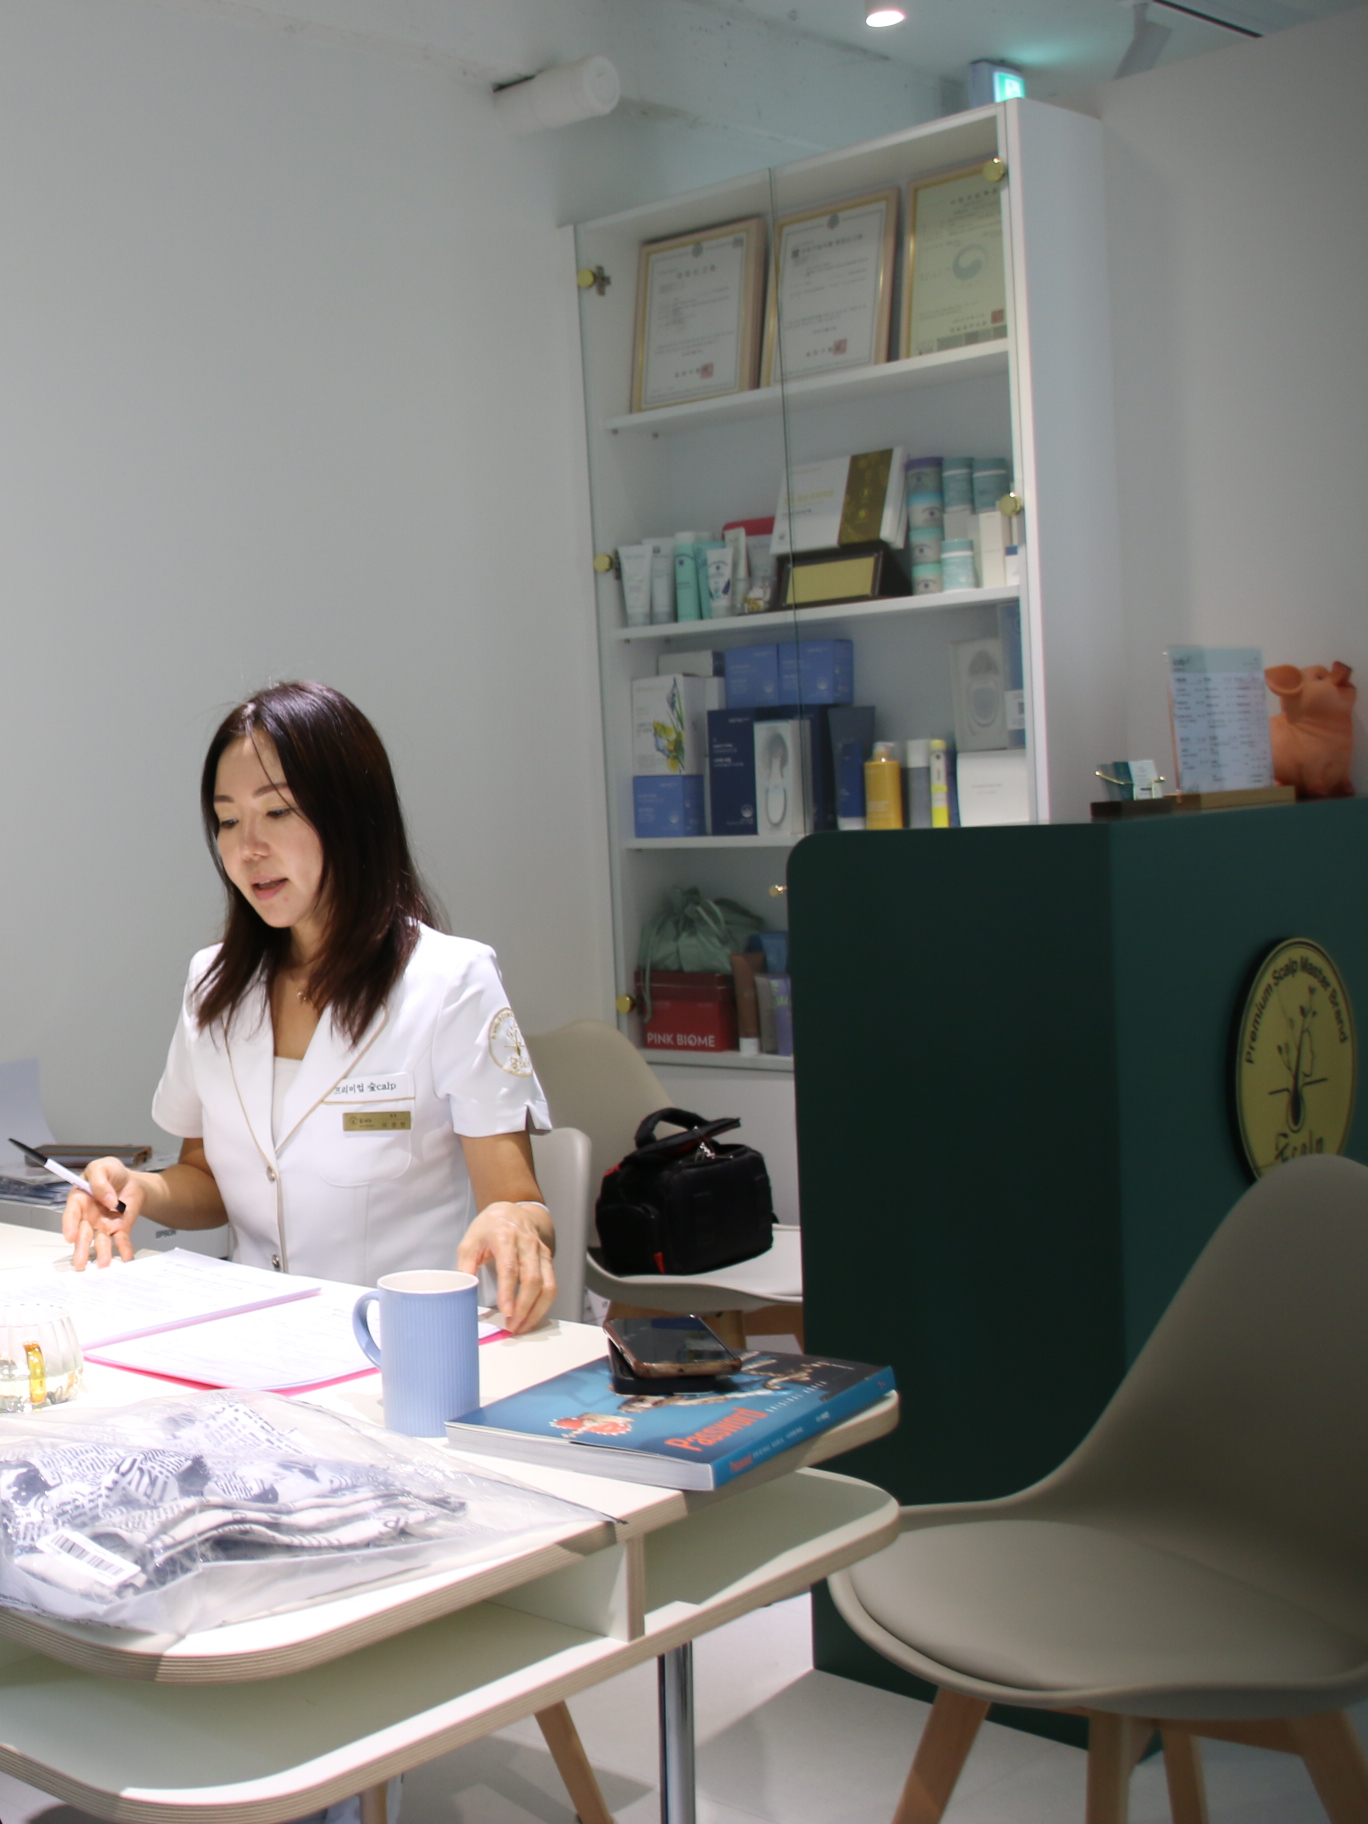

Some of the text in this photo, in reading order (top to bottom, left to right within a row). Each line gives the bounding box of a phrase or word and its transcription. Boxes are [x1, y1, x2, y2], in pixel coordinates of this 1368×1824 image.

[1245, 983, 1274, 1064] Premium
[1271, 957, 1298, 986] Scalp
[646, 1032, 716, 1048] PINK BIOME
[764, 1393, 804, 1413] ORIGINAL
[664, 1406, 768, 1452] Password
